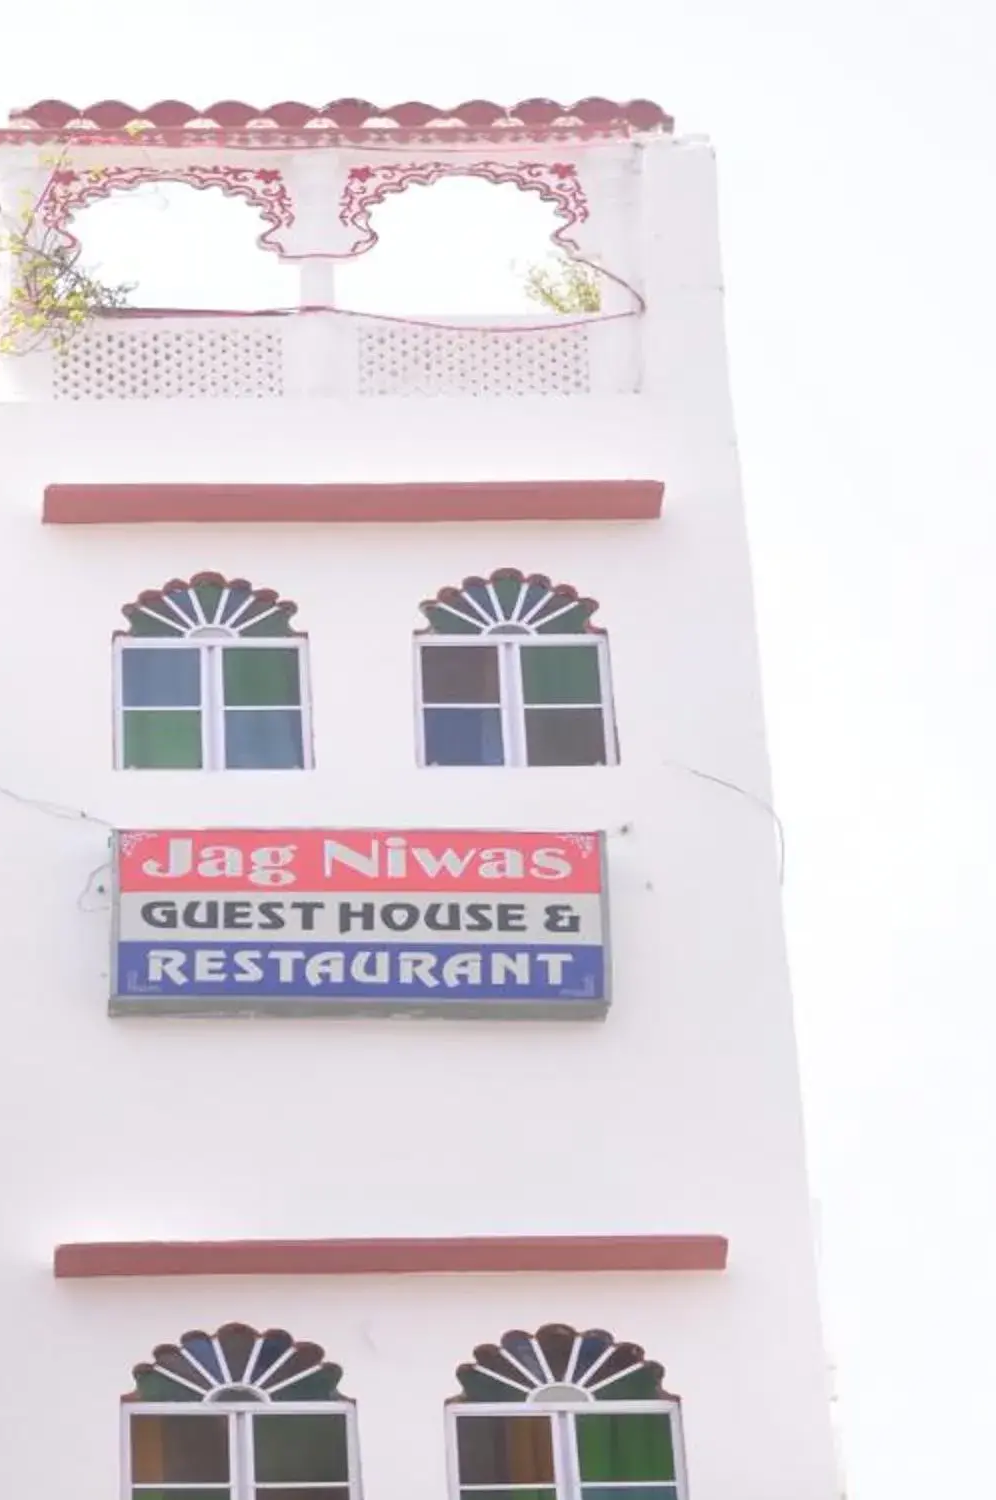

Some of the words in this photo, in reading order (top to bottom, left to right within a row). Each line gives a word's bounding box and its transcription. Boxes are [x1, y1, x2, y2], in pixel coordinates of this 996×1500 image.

[141, 838, 299, 886] Jag
[323, 837, 573, 880] Niwas
[140, 900, 324, 930] GUEST
[339, 902, 528, 934] HOUSE
[543, 904, 581, 933] &
[147, 949, 575, 987] RESTAURANT
